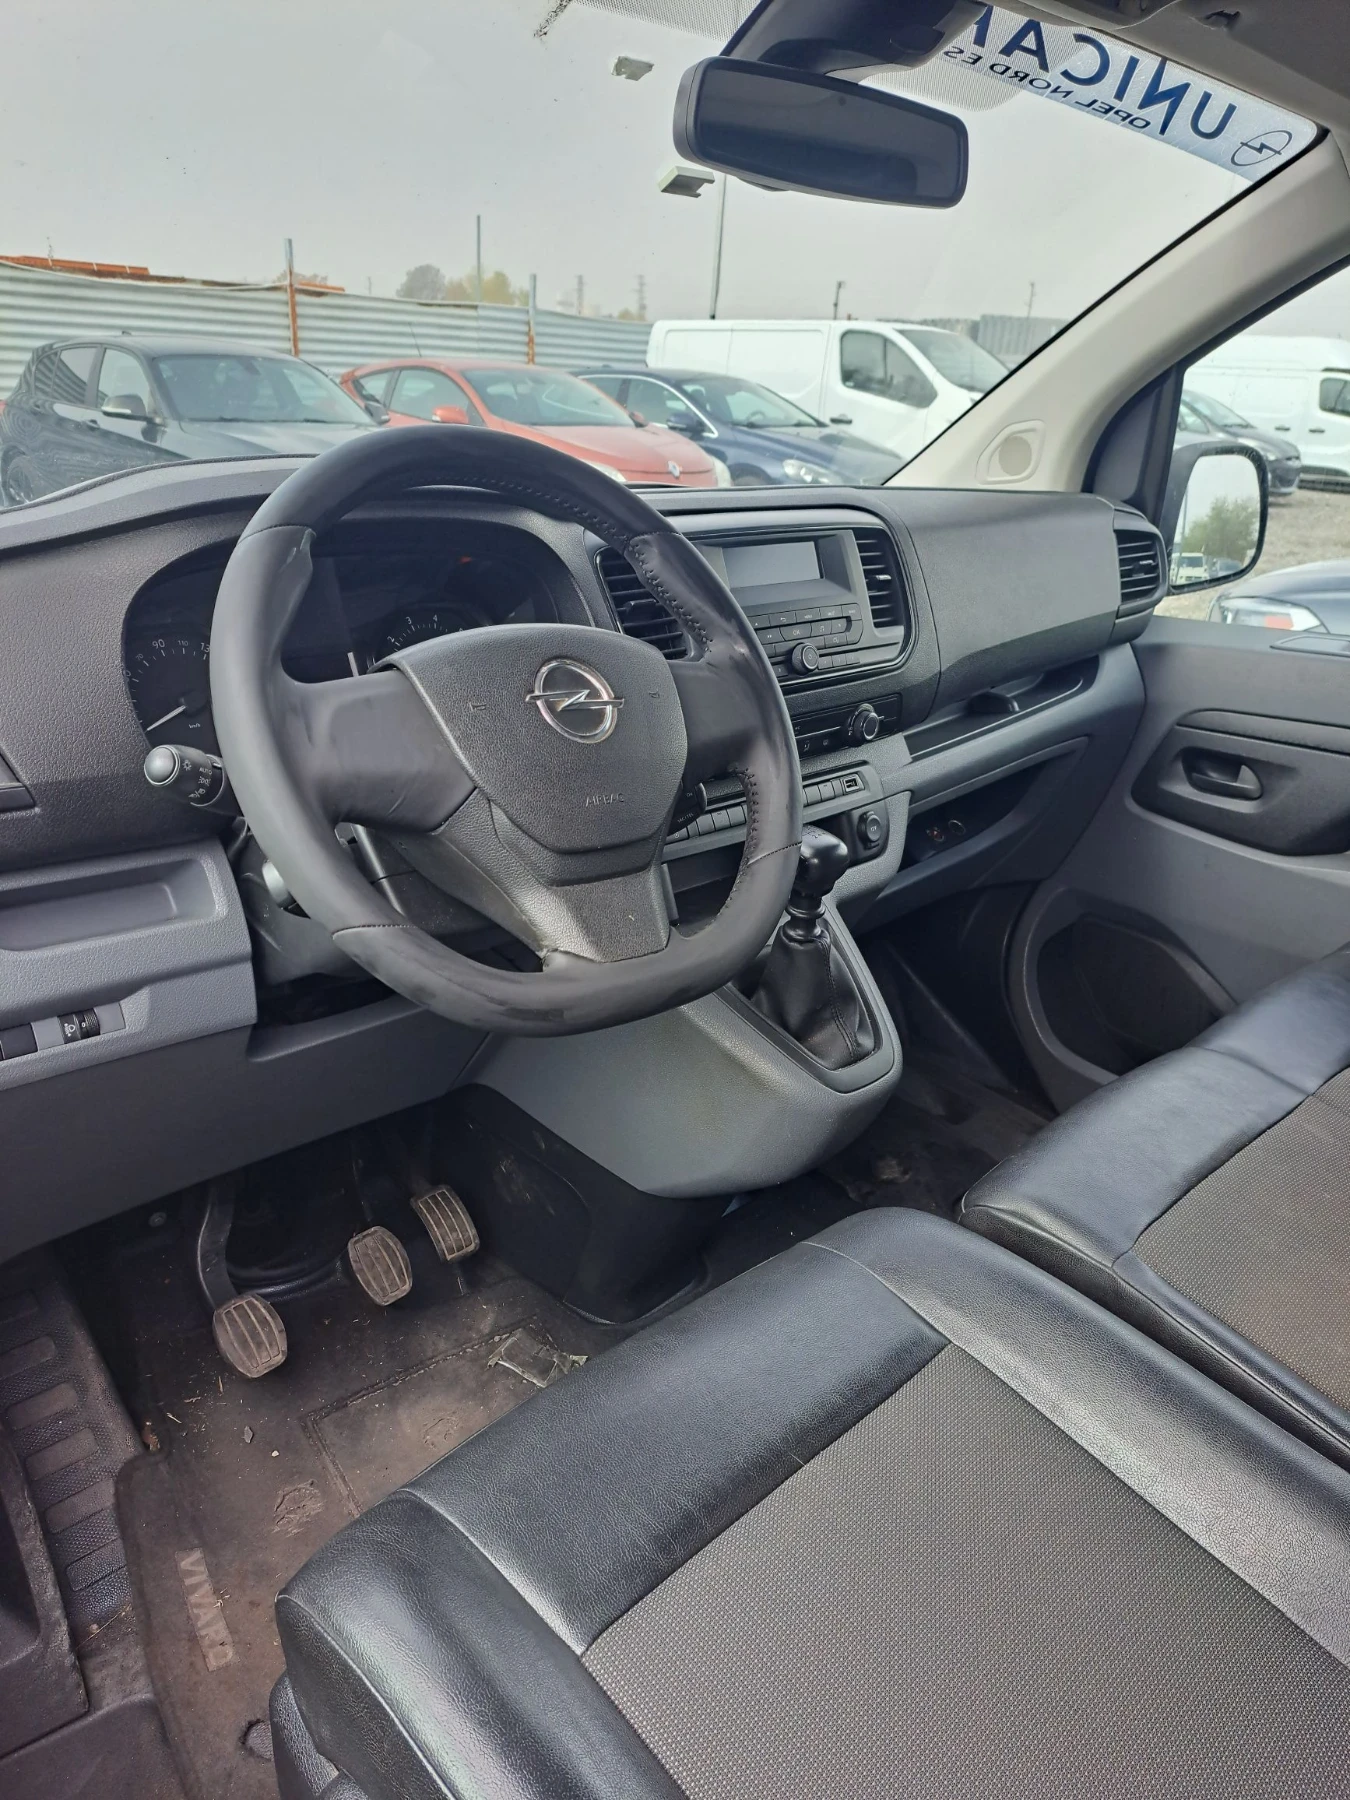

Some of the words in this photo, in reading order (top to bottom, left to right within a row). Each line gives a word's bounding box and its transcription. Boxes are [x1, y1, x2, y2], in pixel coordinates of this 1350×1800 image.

[405, 616, 412, 625] 3
[387, 635, 395, 643] 2
[152, 639, 166, 649] 90
[200, 642, 211, 653] 13
[199, 766, 213, 775] AUTO
